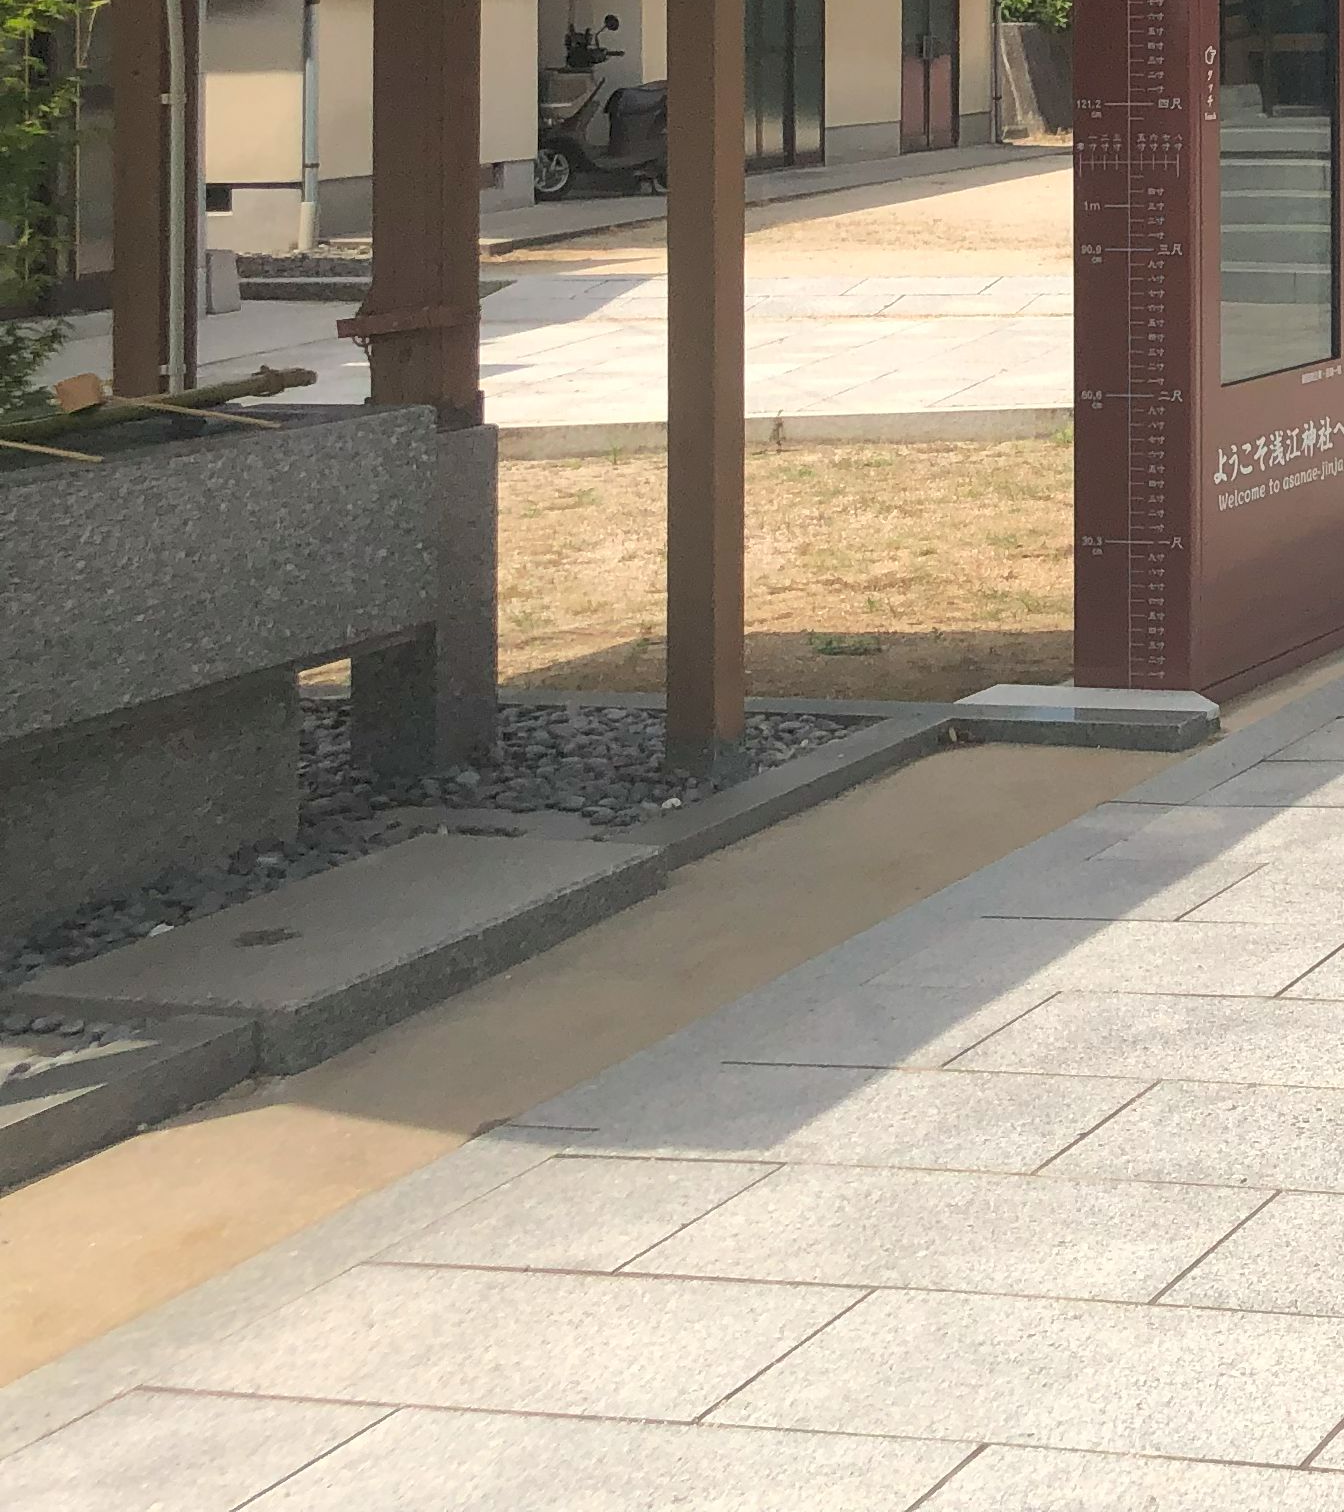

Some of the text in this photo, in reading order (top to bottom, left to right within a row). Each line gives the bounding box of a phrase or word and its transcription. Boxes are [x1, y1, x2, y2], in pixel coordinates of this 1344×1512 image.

[1076, 99, 1102, 109] 121.2
[1158, 98, 1182, 109] 四尺
[1084, 201, 1101, 211] 1m
[1157, 243, 1183, 256] 三尺
[1158, 390, 1183, 402] 二尺
[1218, 457, 1344, 511] Welcome to asanae-jinja
[1158, 537, 1184, 549] 一尺
